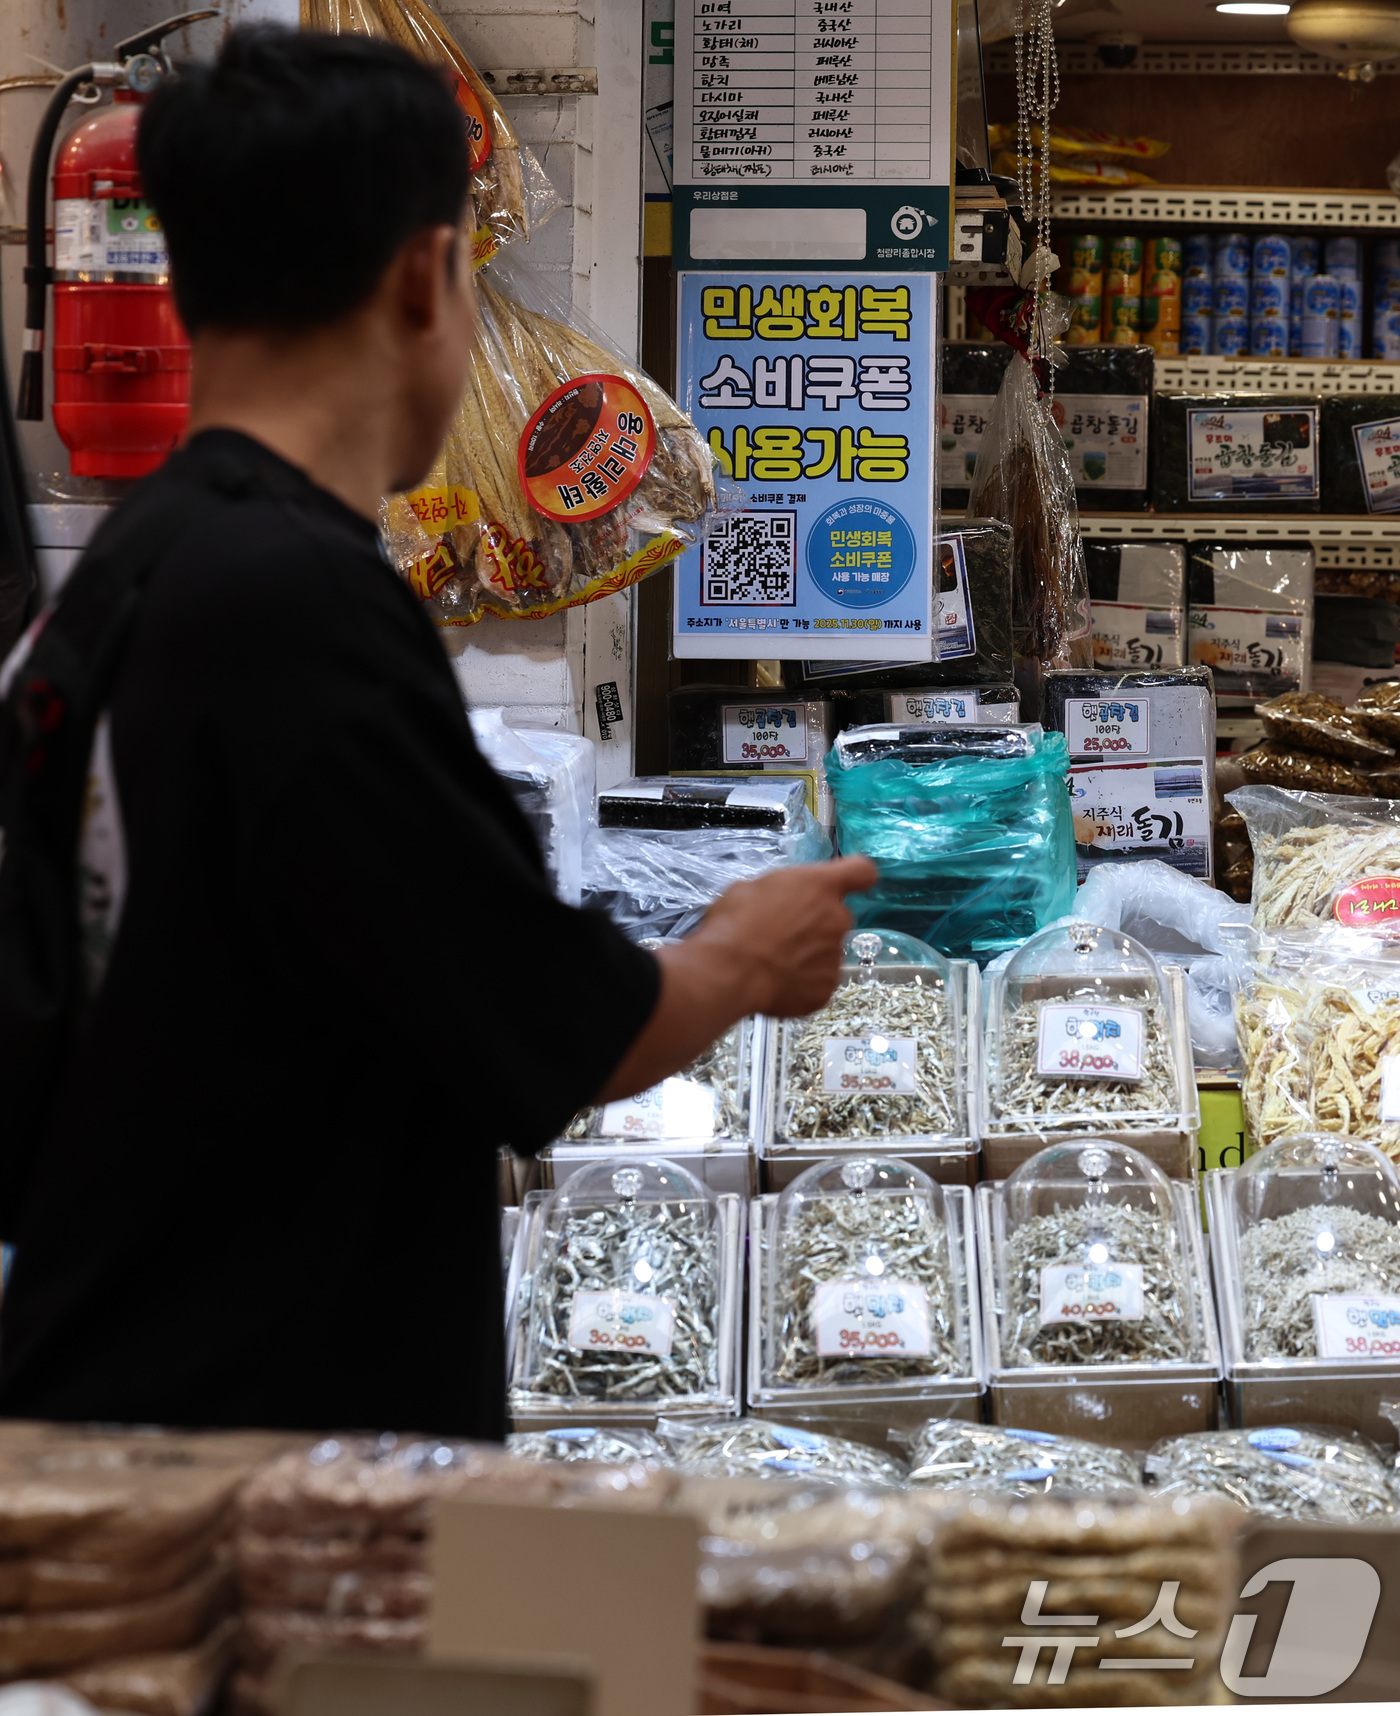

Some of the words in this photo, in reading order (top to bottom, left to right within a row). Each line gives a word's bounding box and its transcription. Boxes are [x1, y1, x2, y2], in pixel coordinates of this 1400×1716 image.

[701, 1, 731, 14] 미역
[813, 1, 853, 14] 국내산
[702, 19, 741, 31] 노가리
[817, 18, 852, 33] 중국산
[702, 36, 759, 51] 황태(채)
[813, 36, 859, 49] 러시아산
[815, 54, 853, 67] 페루산
[701, 73, 729, 87] 한치
[813, 73, 859, 87] 베트남산
[701, 91, 743, 103] 다시마
[815, 89, 854, 104] 국내산
[811, 109, 851, 122] 페루산
[699, 126, 757, 140] 황태껍질
[808, 127, 854, 139] 러시아산
[813, 144, 847, 158] 중국산
[810, 163, 854, 176] 러시아산
[693, 191, 739, 201] 우리상점은
[877, 248, 936, 259] 청량리종합시장
[702, 284, 912, 341] 민생회복
[699, 354, 912, 411] 소비쿠폰
[1070, 413, 1138, 435] 곱창돌김
[568, 428, 611, 474] 자연건조
[707, 425, 911, 482] 사용가능
[1215, 441, 1298, 469] 곱창돌김
[557, 412, 644, 510] 용대리황태
[750, 493, 784, 504] 소비쿠폰
[787, 493, 806, 504] 결제
[825, 508, 848, 526] 회복과
[848, 504, 872, 514] 성장의
[873, 506, 896, 525] 마중물
[830, 530, 893, 548] 민생회복
[829, 551, 892, 568] 소비쿠폰
[832, 572, 850, 582] 사용
[852, 572, 870, 582] 가능
[871, 572, 890, 582] 매장
[687, 618, 722, 628] 주소지가
[792, 618, 810, 629] 가능
[905, 620, 921, 631] 사용
[1211, 638, 1241, 651] 지주식
[1099, 648, 1126, 661] 재래
[1126, 637, 1163, 669] 돌김
[1219, 651, 1247, 665] 재래
[1246, 641, 1283, 676] 돌김
[906, 698, 966, 718] 햇곱창김
[1082, 702, 1139, 722] 햇곱창김
[738, 708, 797, 729] 햇곱창김
[1082, 806, 1122, 821] 지주식
[1096, 823, 1134, 841] 재래
[1131, 806, 1184, 849] 돌김
[1350, 899, 1400, 915] 대리
